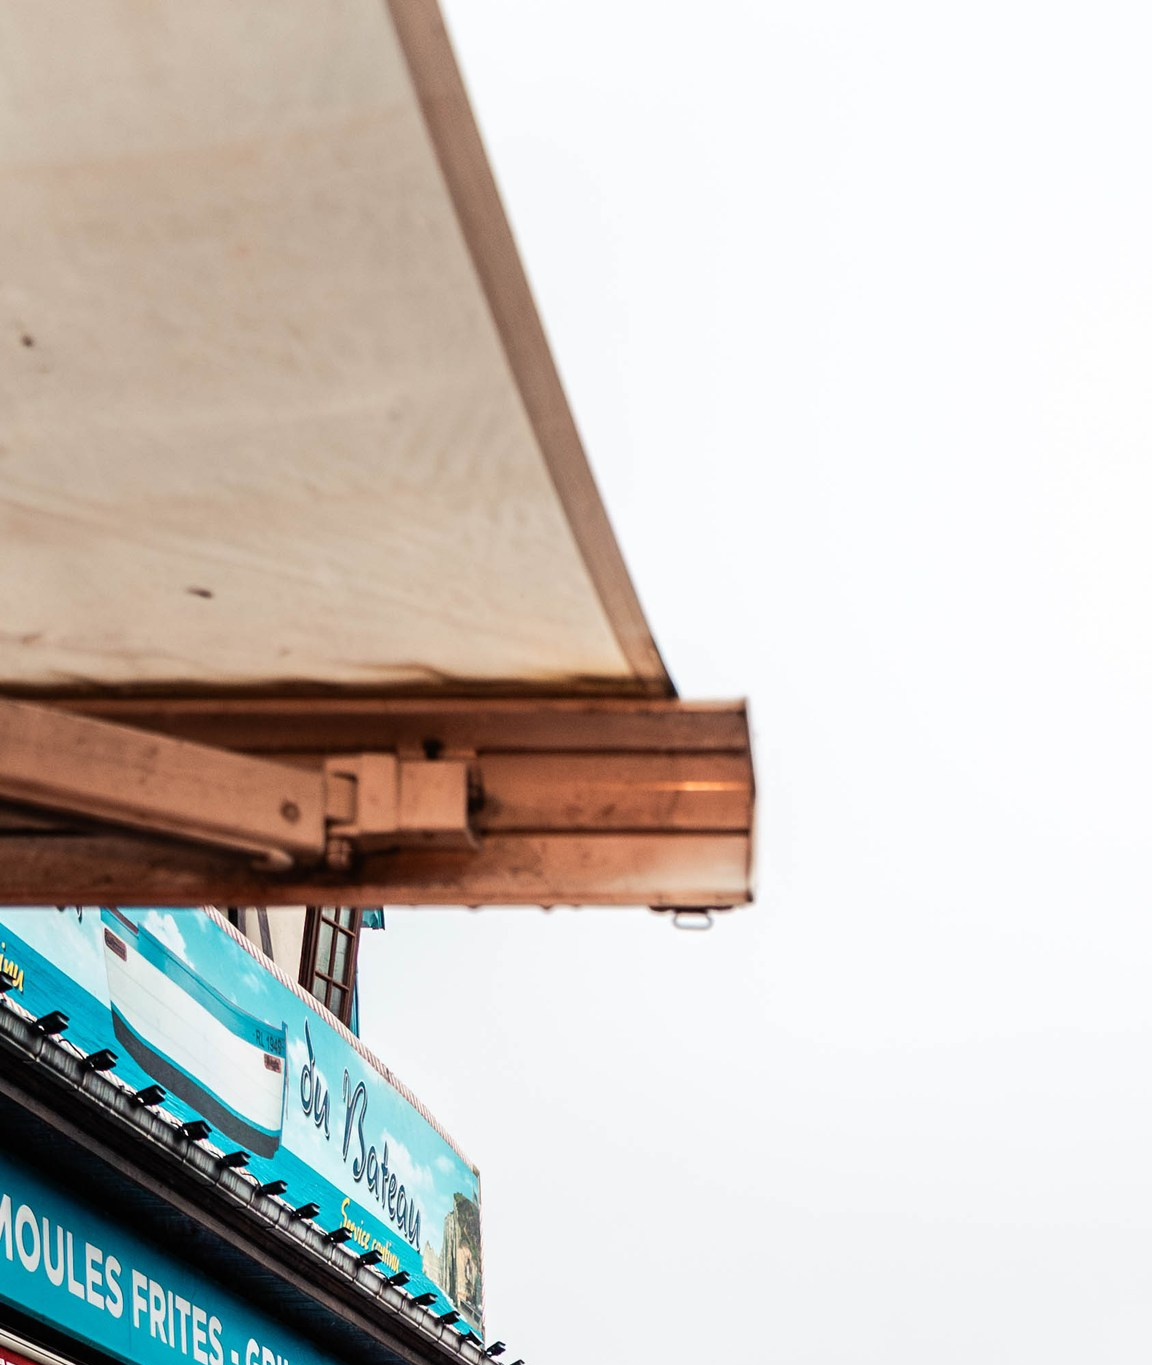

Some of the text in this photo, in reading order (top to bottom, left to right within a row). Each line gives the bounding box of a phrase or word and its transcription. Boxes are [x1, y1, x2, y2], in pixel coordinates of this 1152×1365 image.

[301, 1016, 422, 1252] du Bateau
[340, 1197, 372, 1252] Service
